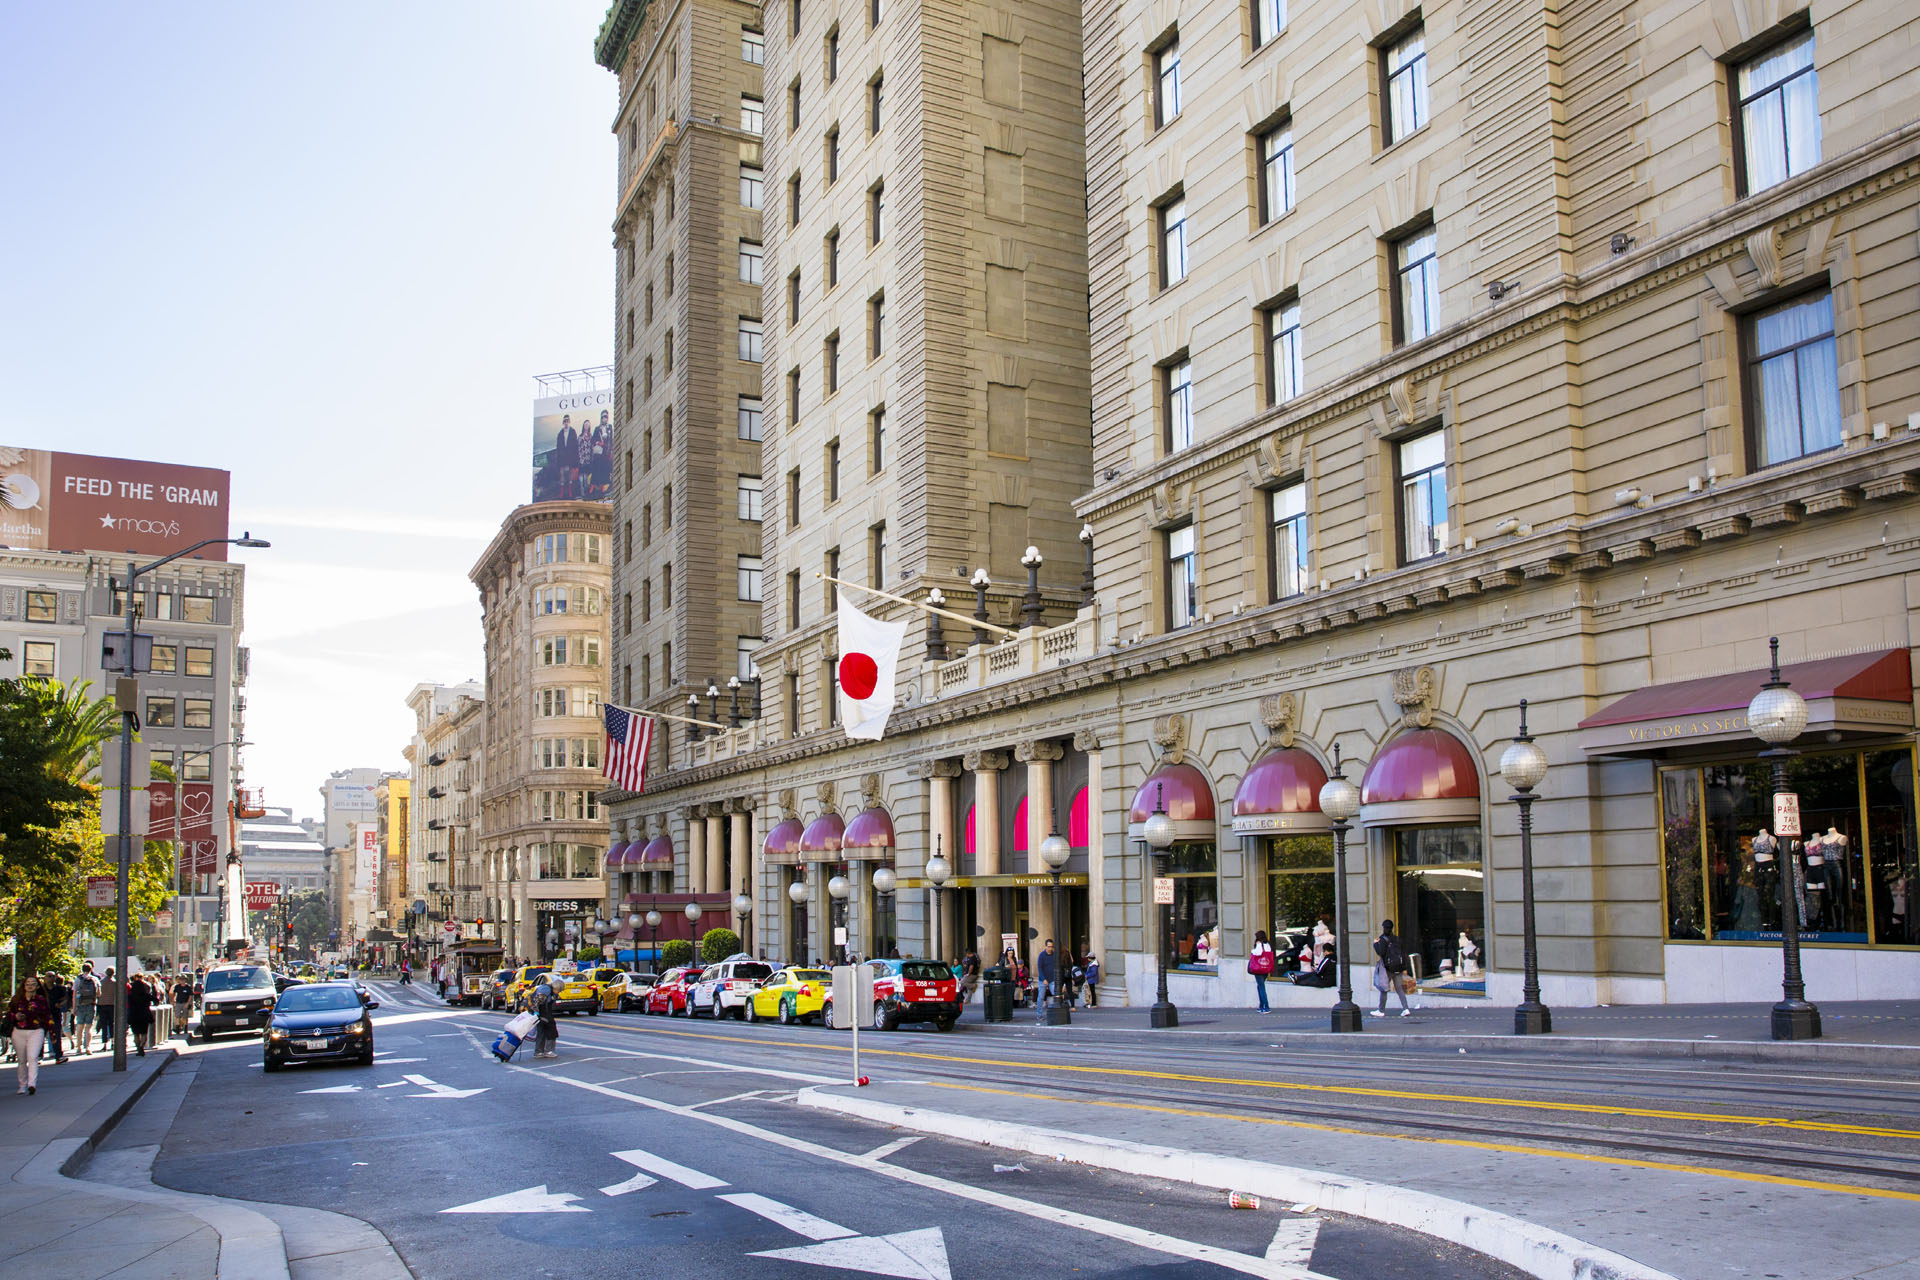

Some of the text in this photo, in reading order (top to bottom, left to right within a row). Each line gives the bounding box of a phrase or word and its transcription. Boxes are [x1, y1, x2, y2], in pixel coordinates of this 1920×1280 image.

[559, 393, 612, 410] GUCCI
[64, 476, 219, 507] FEED THE 'GRAM
[118, 517, 180, 538] macy's
[1629, 716, 1748, 741] VICTORIA'S SEC
[1785, 796, 1794, 805] NO
[1255, 818, 1296, 829] SECRET
[245, 884, 279, 895] OTEL
[245, 895, 278, 904] ATFORD
[533, 901, 578, 911] EXPRESS
